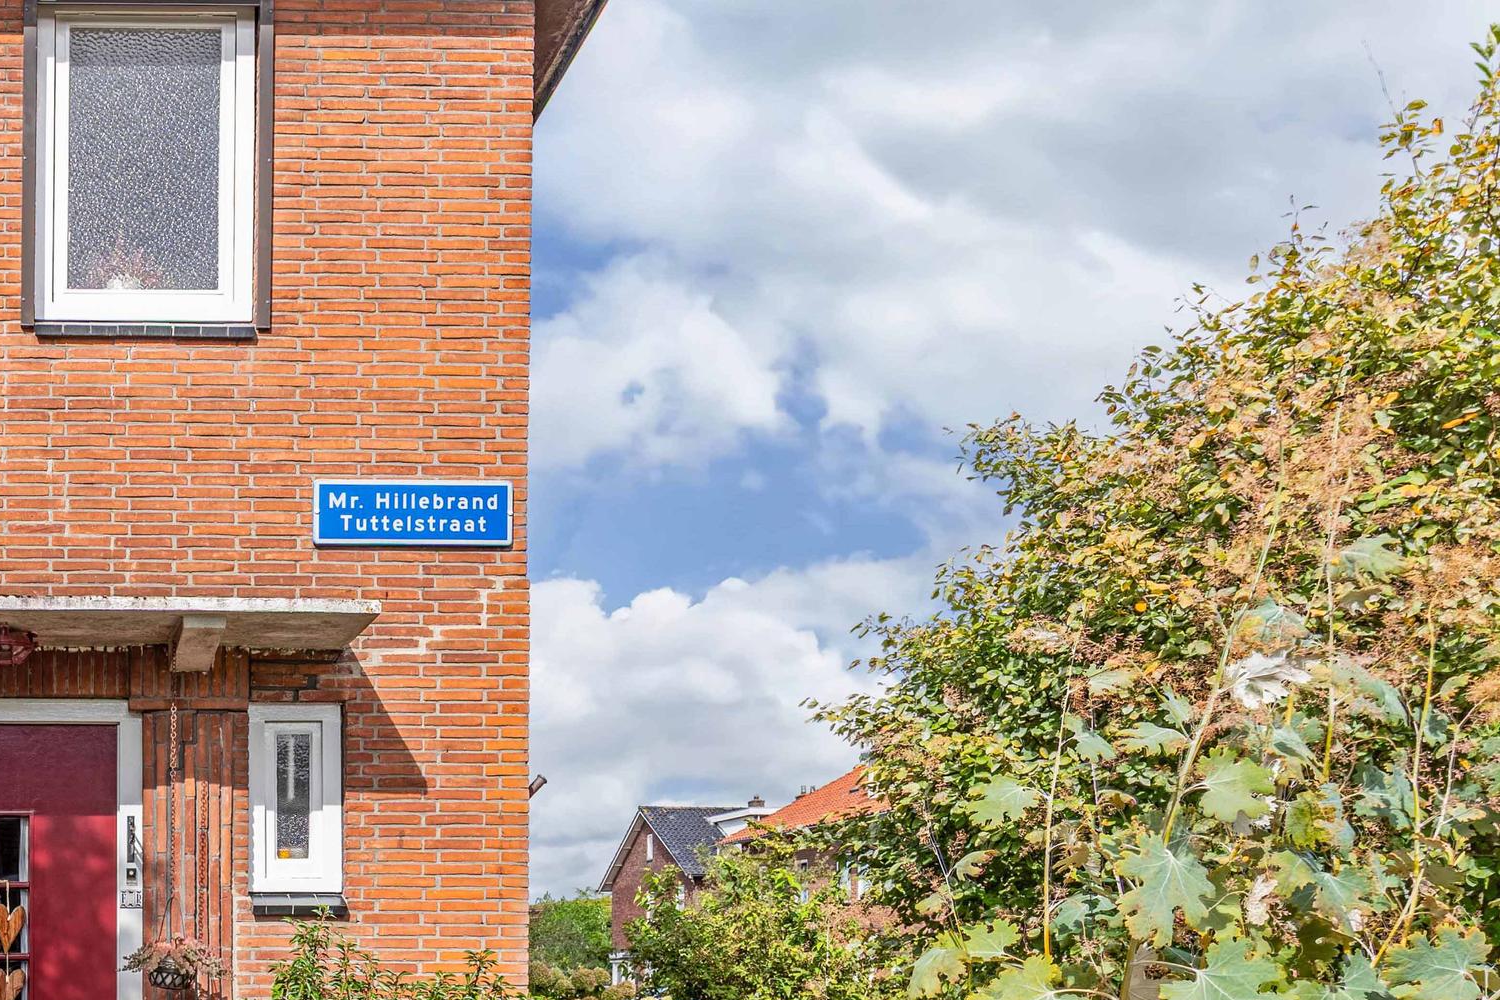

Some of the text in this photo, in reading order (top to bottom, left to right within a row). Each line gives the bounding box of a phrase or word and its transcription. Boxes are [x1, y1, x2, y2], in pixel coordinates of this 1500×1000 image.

[328, 492, 499, 510] Mr. Hillebrand
[340, 515, 487, 533] Tuttelstraat
